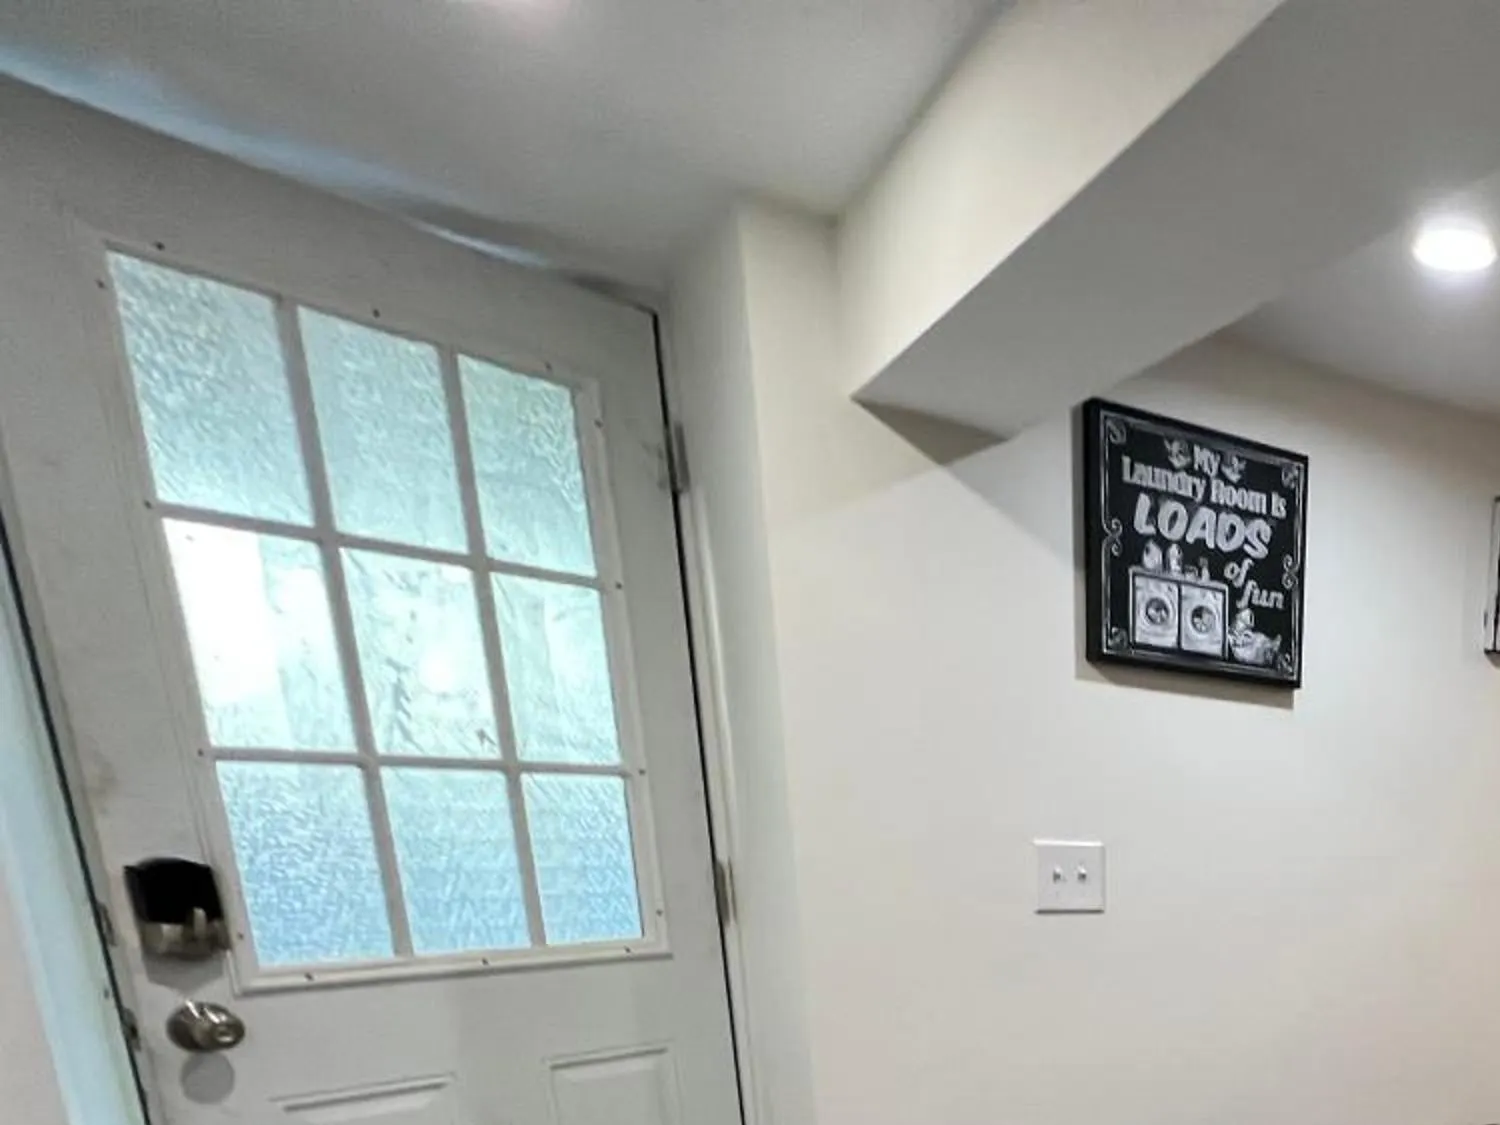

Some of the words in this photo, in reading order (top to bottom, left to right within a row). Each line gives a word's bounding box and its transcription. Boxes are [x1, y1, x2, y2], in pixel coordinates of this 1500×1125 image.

[1193, 445, 1221, 478] My
[1121, 455, 1206, 501] Laundry
[1211, 477, 1267, 514] Room
[1133, 493, 1273, 559] LOADS
[1223, 558, 1254, 588] of
[1236, 579, 1285, 610] fun
